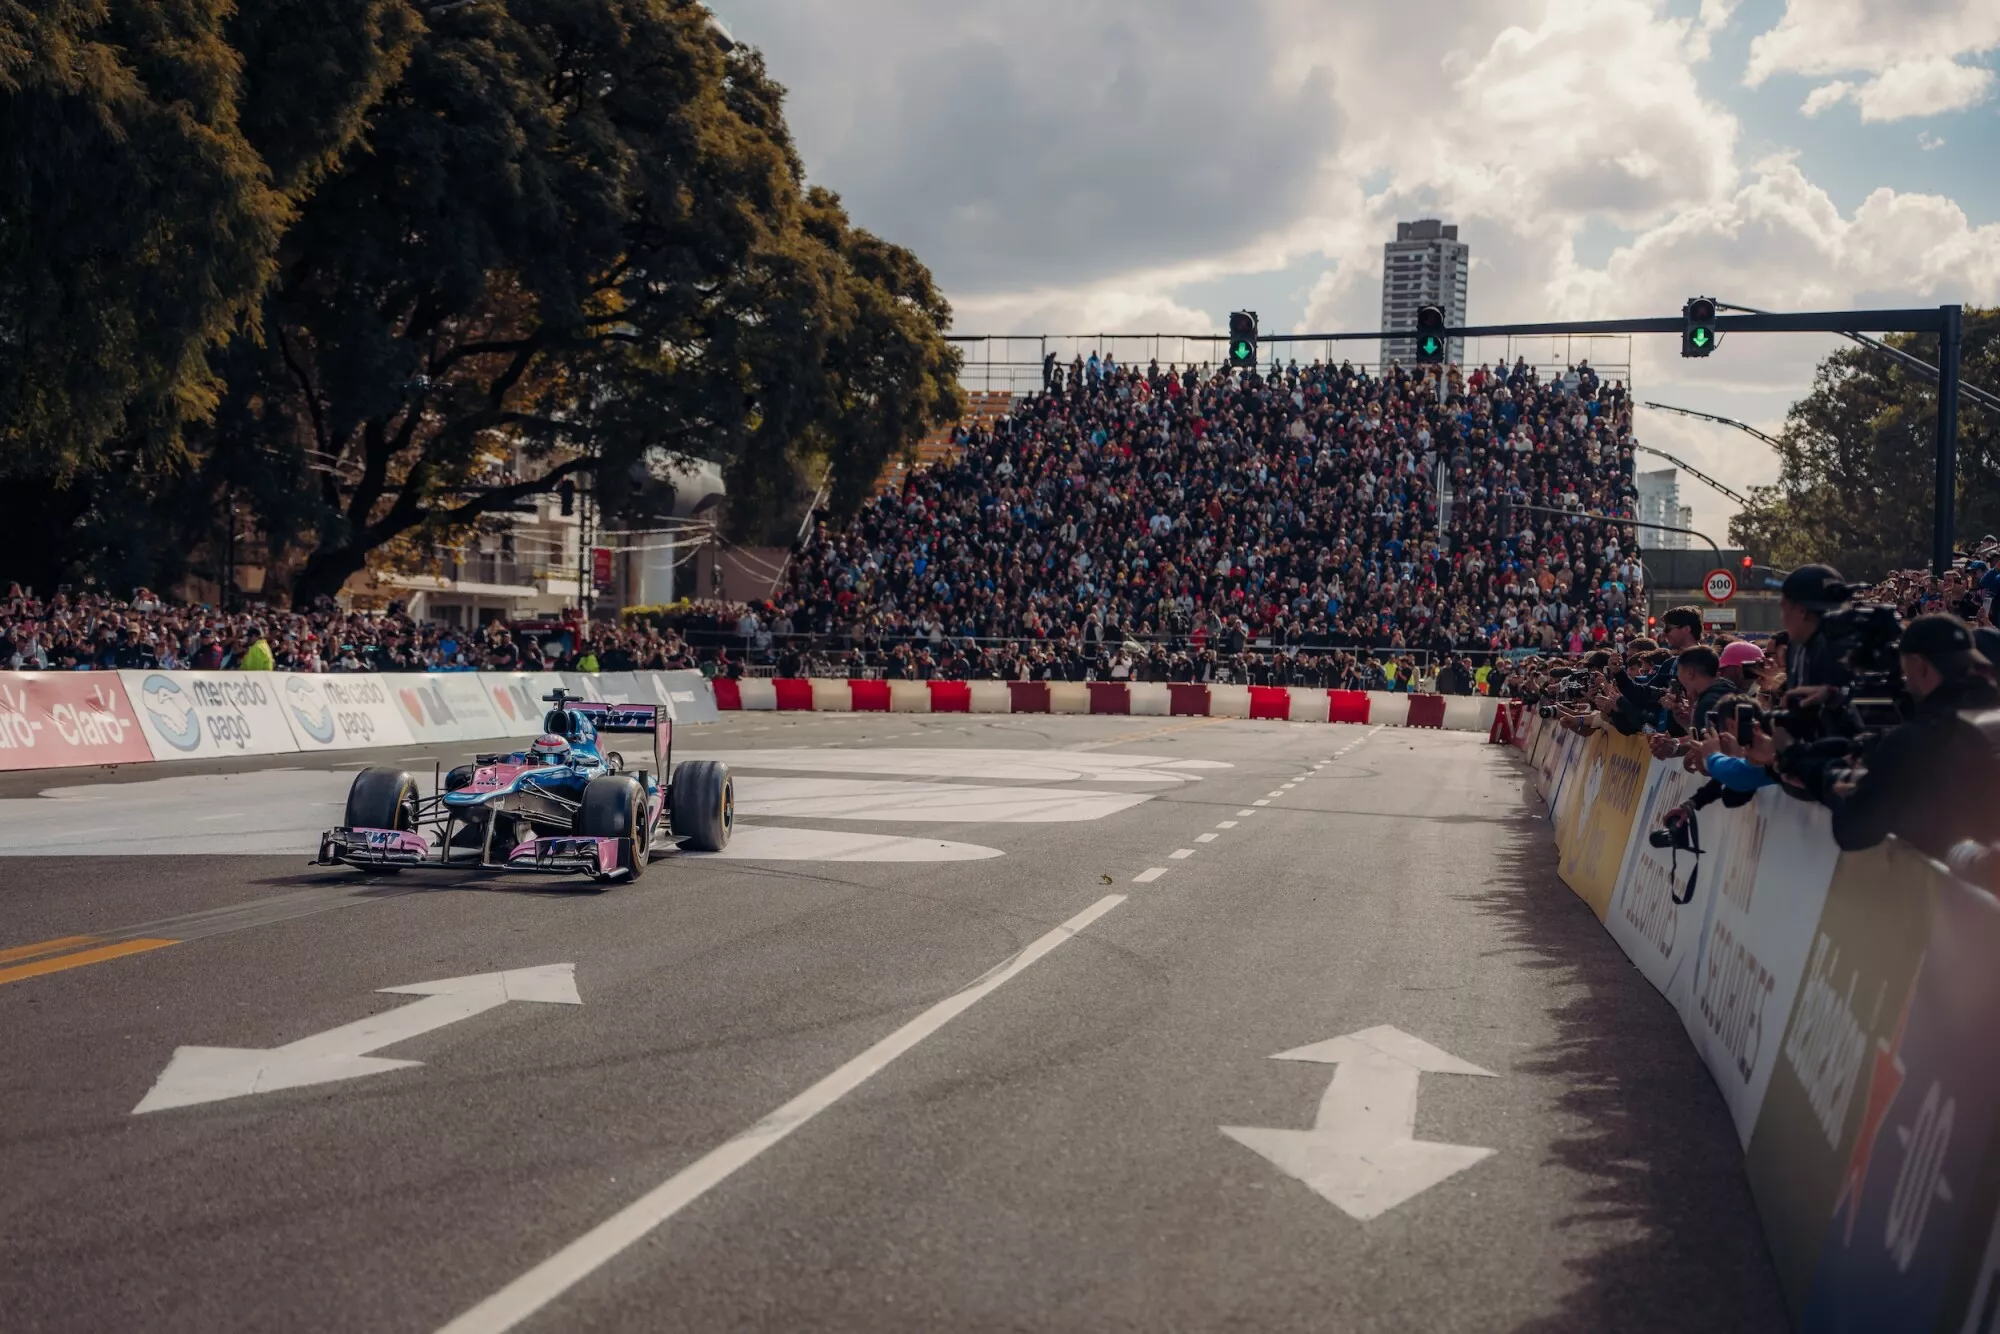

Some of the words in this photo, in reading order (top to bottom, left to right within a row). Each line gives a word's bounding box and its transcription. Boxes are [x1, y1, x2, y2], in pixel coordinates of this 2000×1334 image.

[1709, 580, 1731, 590] 300
[193, 675, 267, 708] mercado
[323, 674, 385, 706] mercado
[51, 703, 124, 747] Claro
[207, 712, 252, 749] pago
[338, 711, 375, 742] pago
[1700, 919, 1776, 1084] SECURITIES
[1785, 932, 1867, 1151] Heineken
